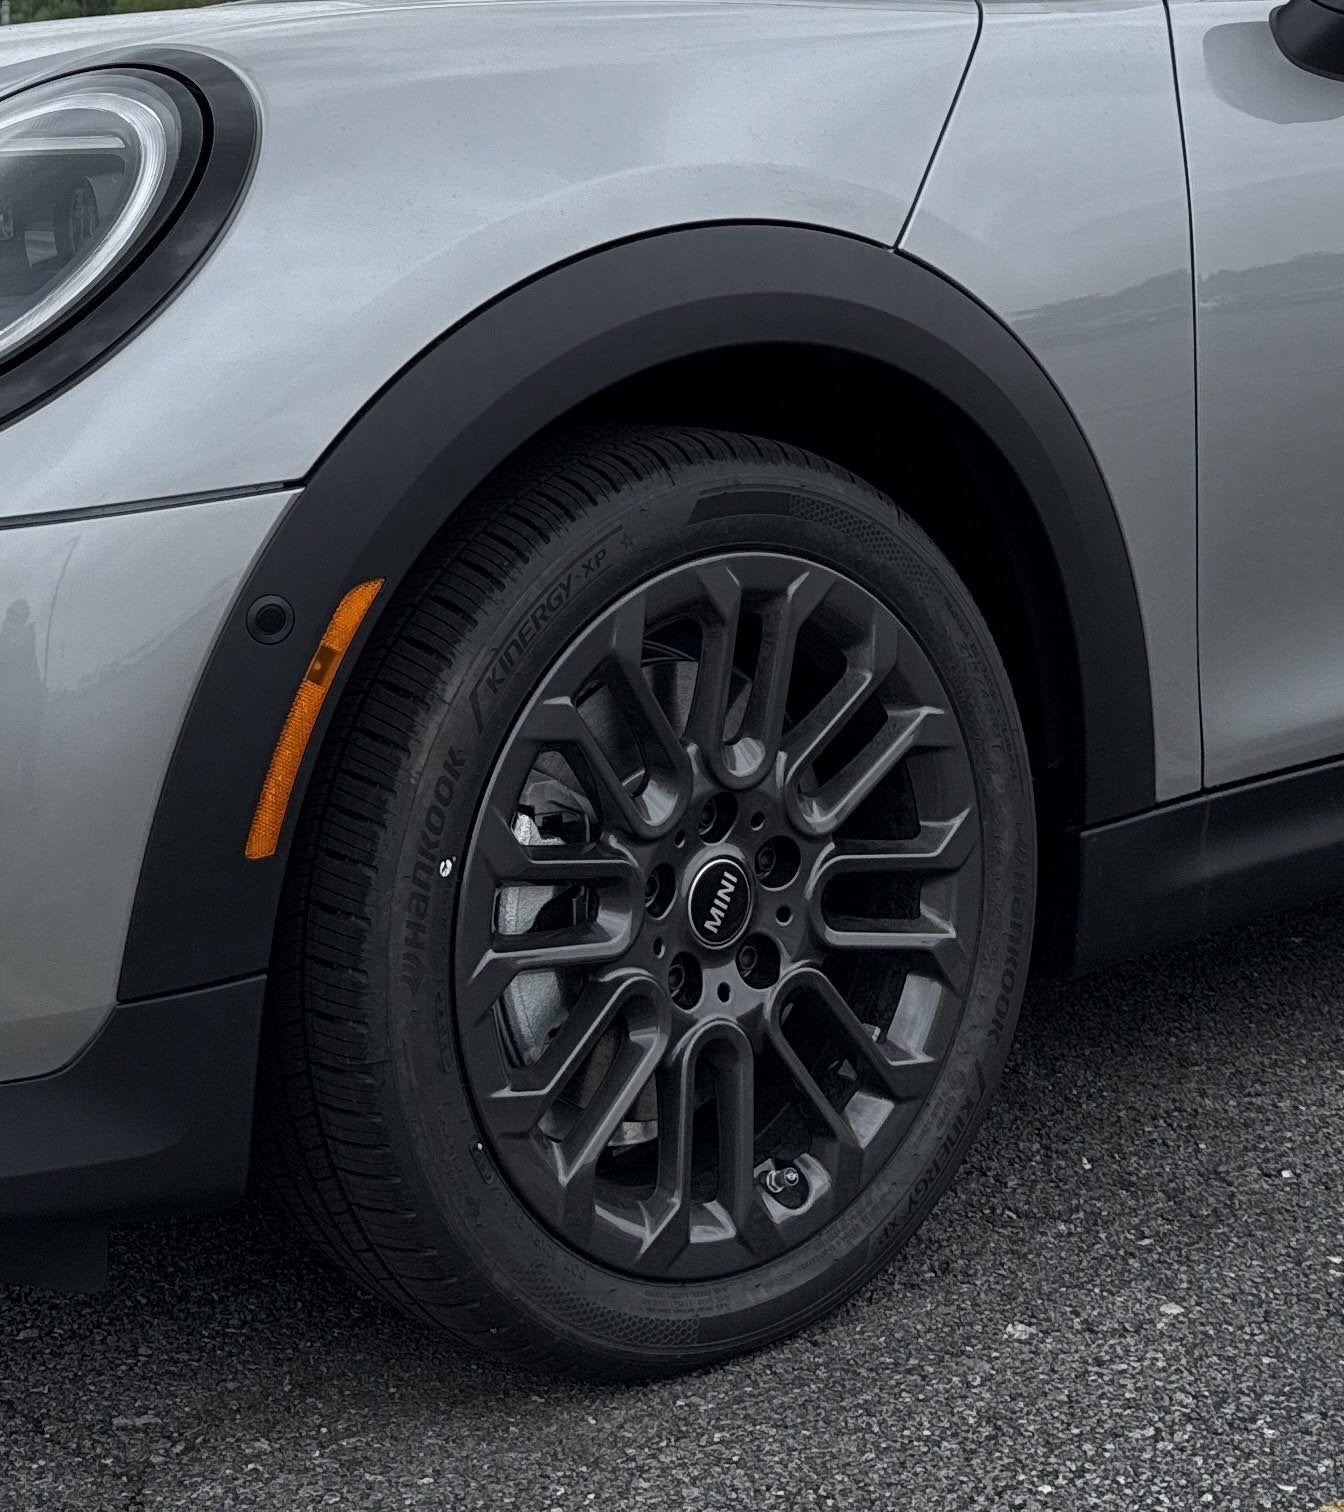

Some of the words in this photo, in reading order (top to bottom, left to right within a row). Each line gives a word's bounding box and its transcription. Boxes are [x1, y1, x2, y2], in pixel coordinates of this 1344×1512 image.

[485, 573, 573, 695] KINERGY
[581, 548, 607, 579] XP
[704, 871, 738, 934] MINI
